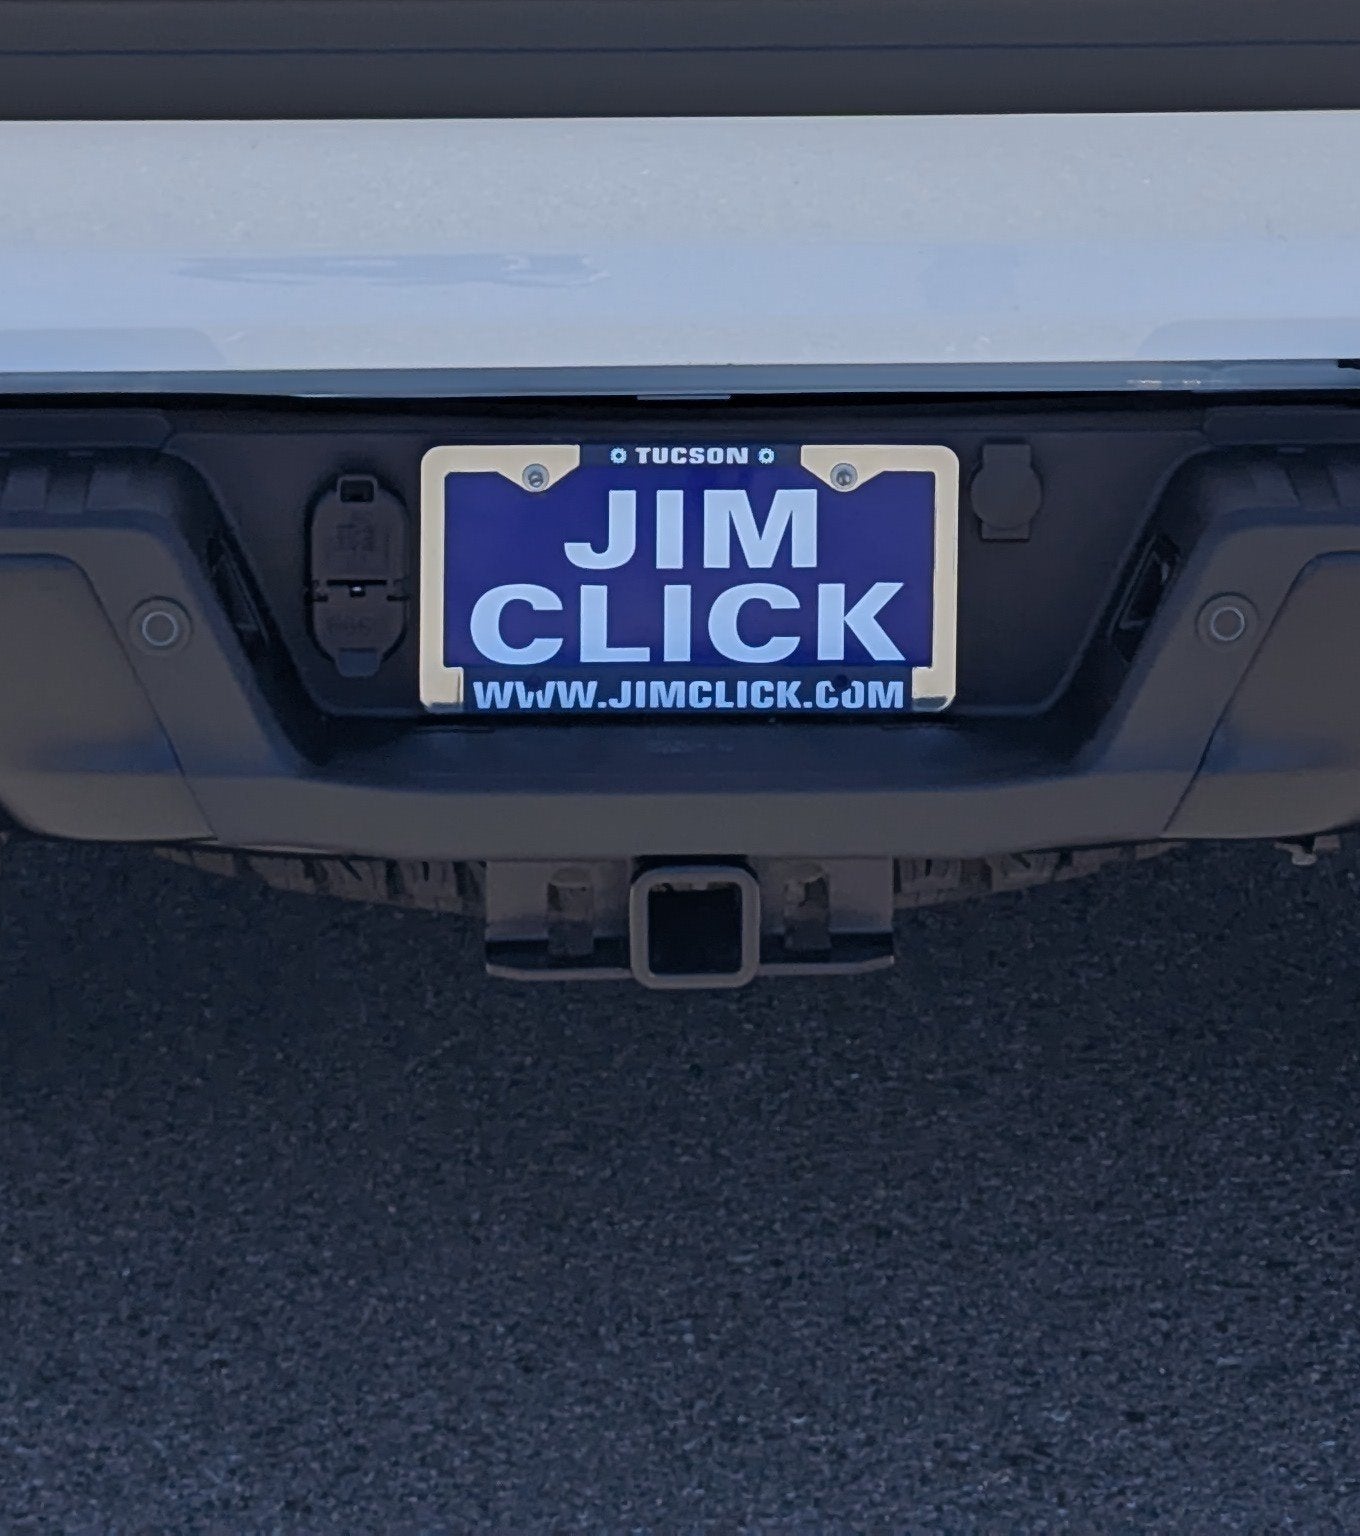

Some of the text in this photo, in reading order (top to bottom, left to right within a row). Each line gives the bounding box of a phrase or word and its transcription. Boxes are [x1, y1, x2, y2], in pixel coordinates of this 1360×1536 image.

[635, 448, 748, 464] TUCSON
[564, 489, 817, 569] JIM
[470, 582, 906, 664] CLICK
[474, 680, 903, 709] WWW.JIMCLICK.COM
